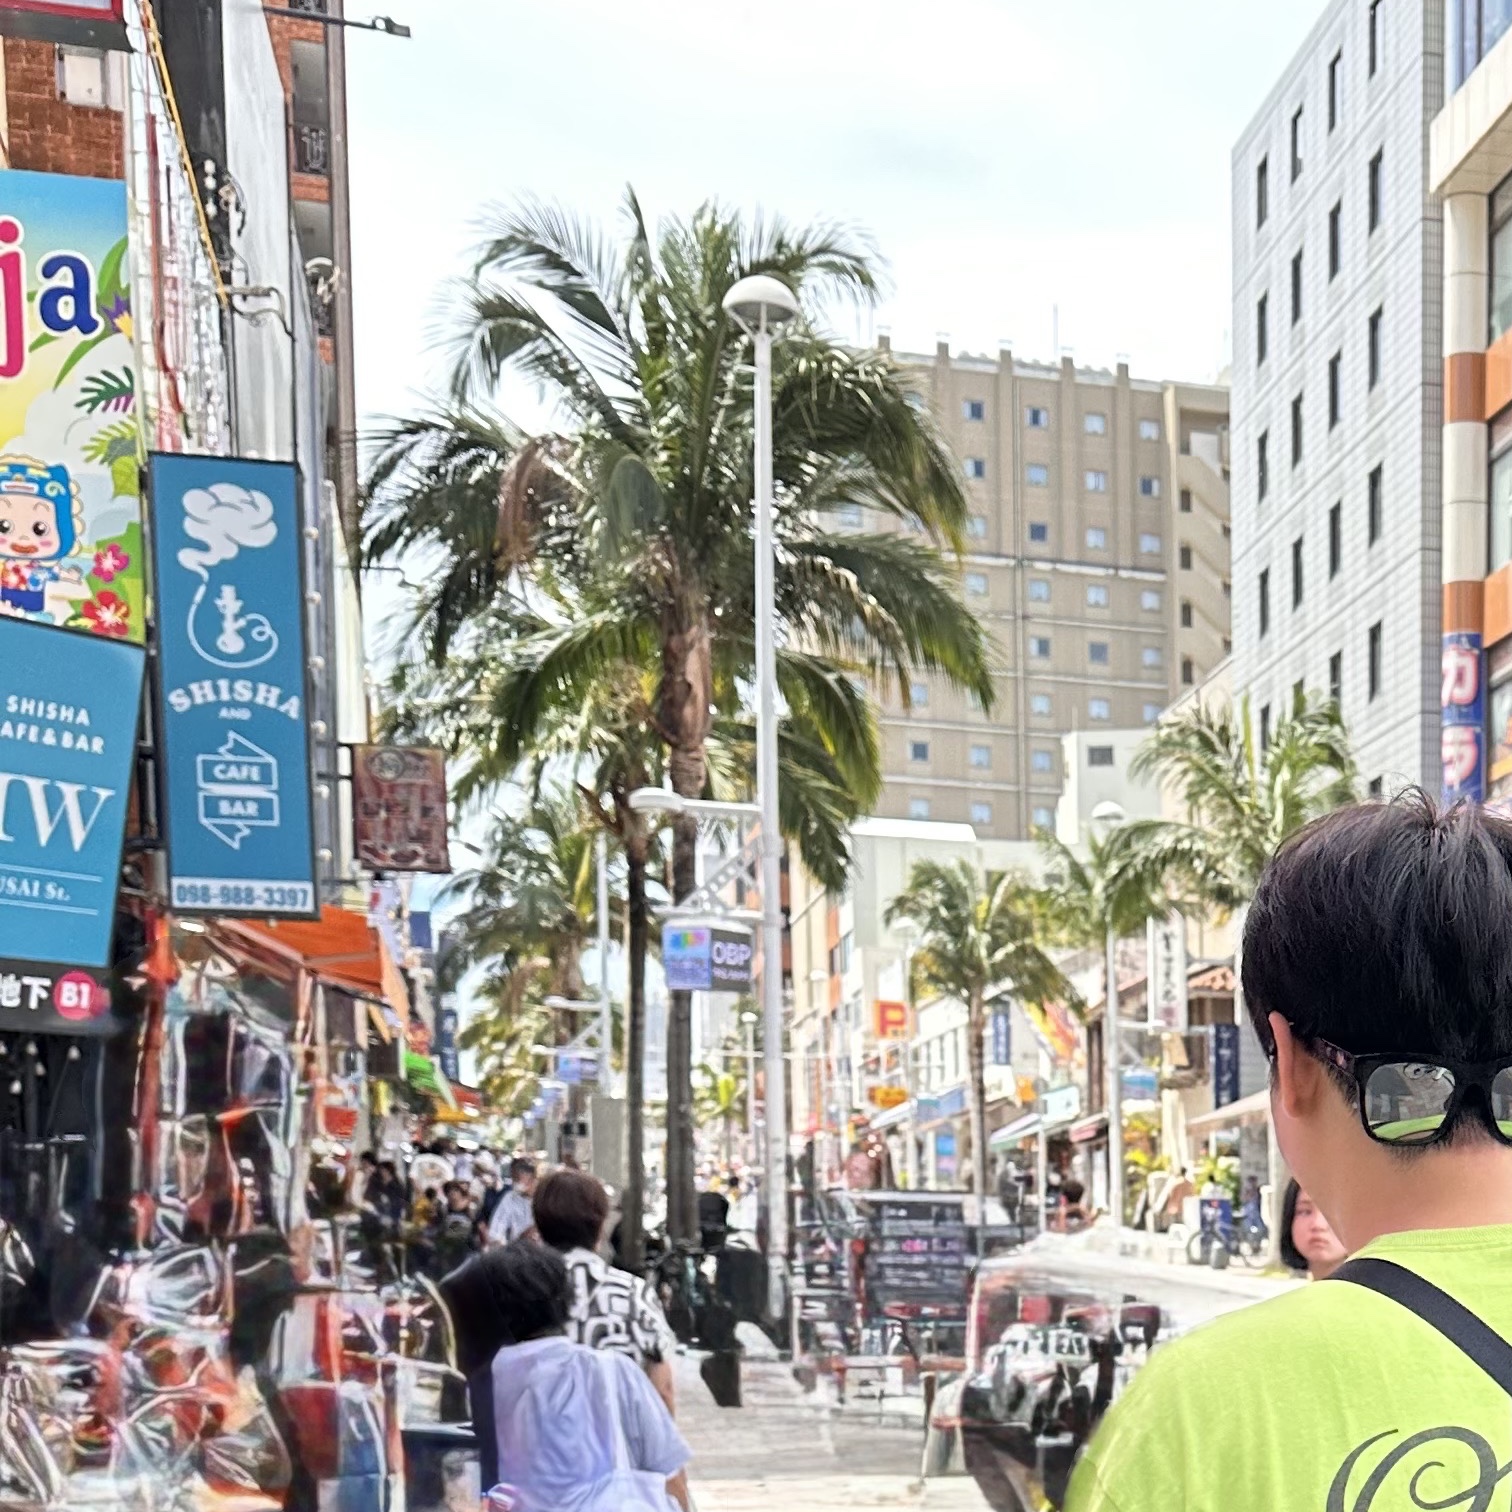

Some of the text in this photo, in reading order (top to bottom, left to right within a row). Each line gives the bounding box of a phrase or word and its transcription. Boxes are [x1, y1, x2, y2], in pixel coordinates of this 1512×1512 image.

[6, 694, 90, 727] SHISHA
[168, 679, 300, 720] SHISHA
[218, 707, 252, 721] AND
[212, 763, 261, 782] CAFE
[218, 799, 259, 817] BAR
[60, 981, 91, 1010] B1
